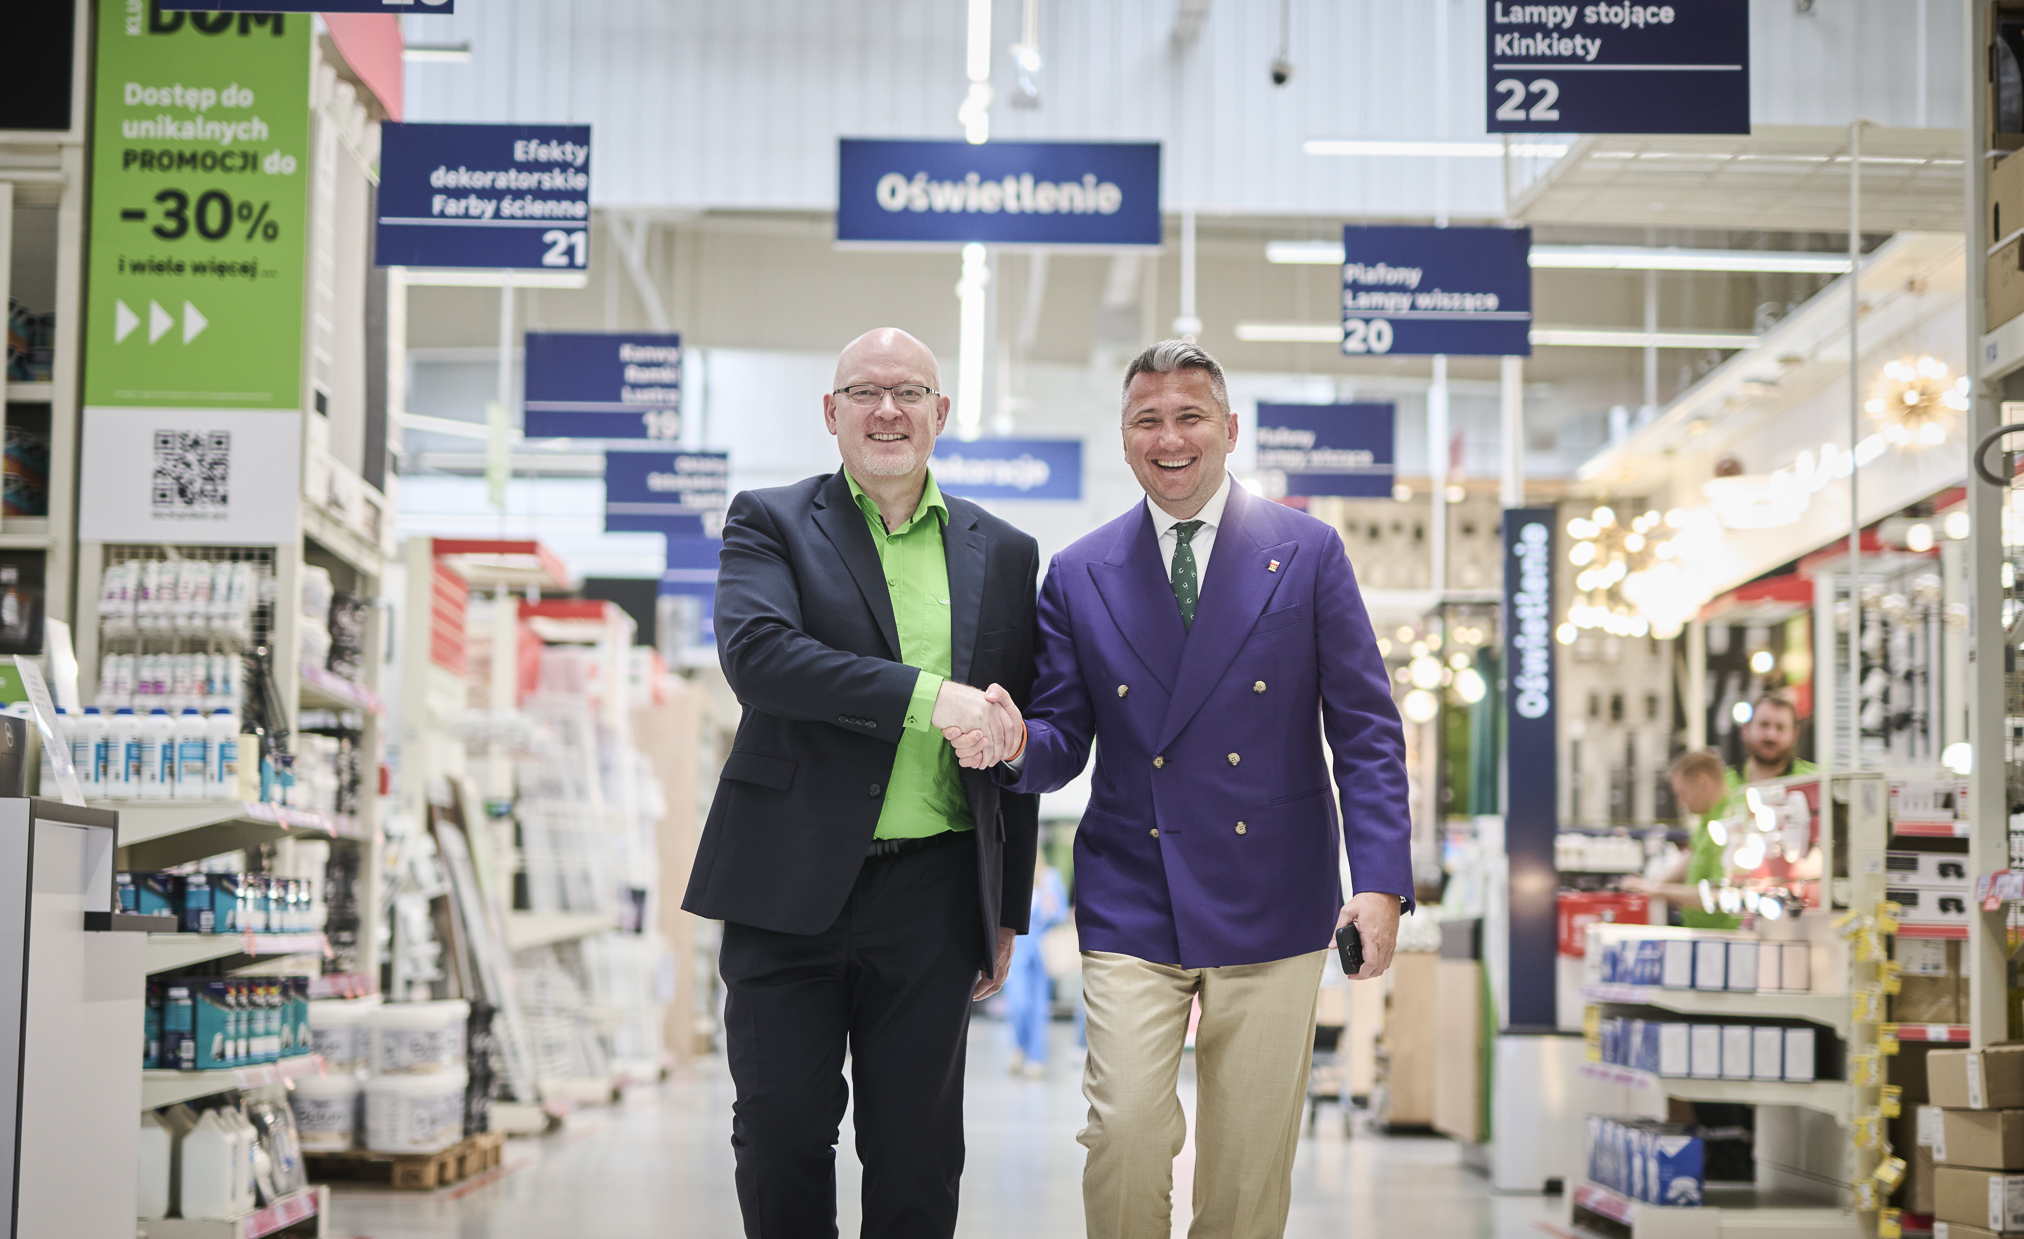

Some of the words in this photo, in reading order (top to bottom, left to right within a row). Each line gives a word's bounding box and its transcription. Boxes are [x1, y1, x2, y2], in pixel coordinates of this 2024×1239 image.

[1494, 1, 1578, 29] Lampy
[1584, 0, 1676, 29] stojące
[1494, 32, 1602, 61] Kinkiety
[124, 82, 217, 112] Dostęp
[220, 82, 255, 108] do
[1494, 79, 1560, 121] 22
[122, 114, 269, 146] unikalnych
[122, 149, 258, 174] PROMOCJI
[263, 149, 297, 175] do
[514, 139, 588, 167] Efekty
[430, 165, 589, 191] dekoratorskie
[432, 194, 497, 220] Farby
[499, 195, 588, 219] ścienne
[876, 171, 1122, 215] Oświetlenie
[120, 187, 280, 242] -30%
[541, 230, 587, 267] 21
[118, 254, 125, 275] i
[129, 255, 186, 276] wiele
[190, 256, 258, 281] więcej
[1344, 288, 1413, 314] Lampy
[1343, 317, 1393, 354] 20
[1513, 522, 1549, 719] Oświetlenie
